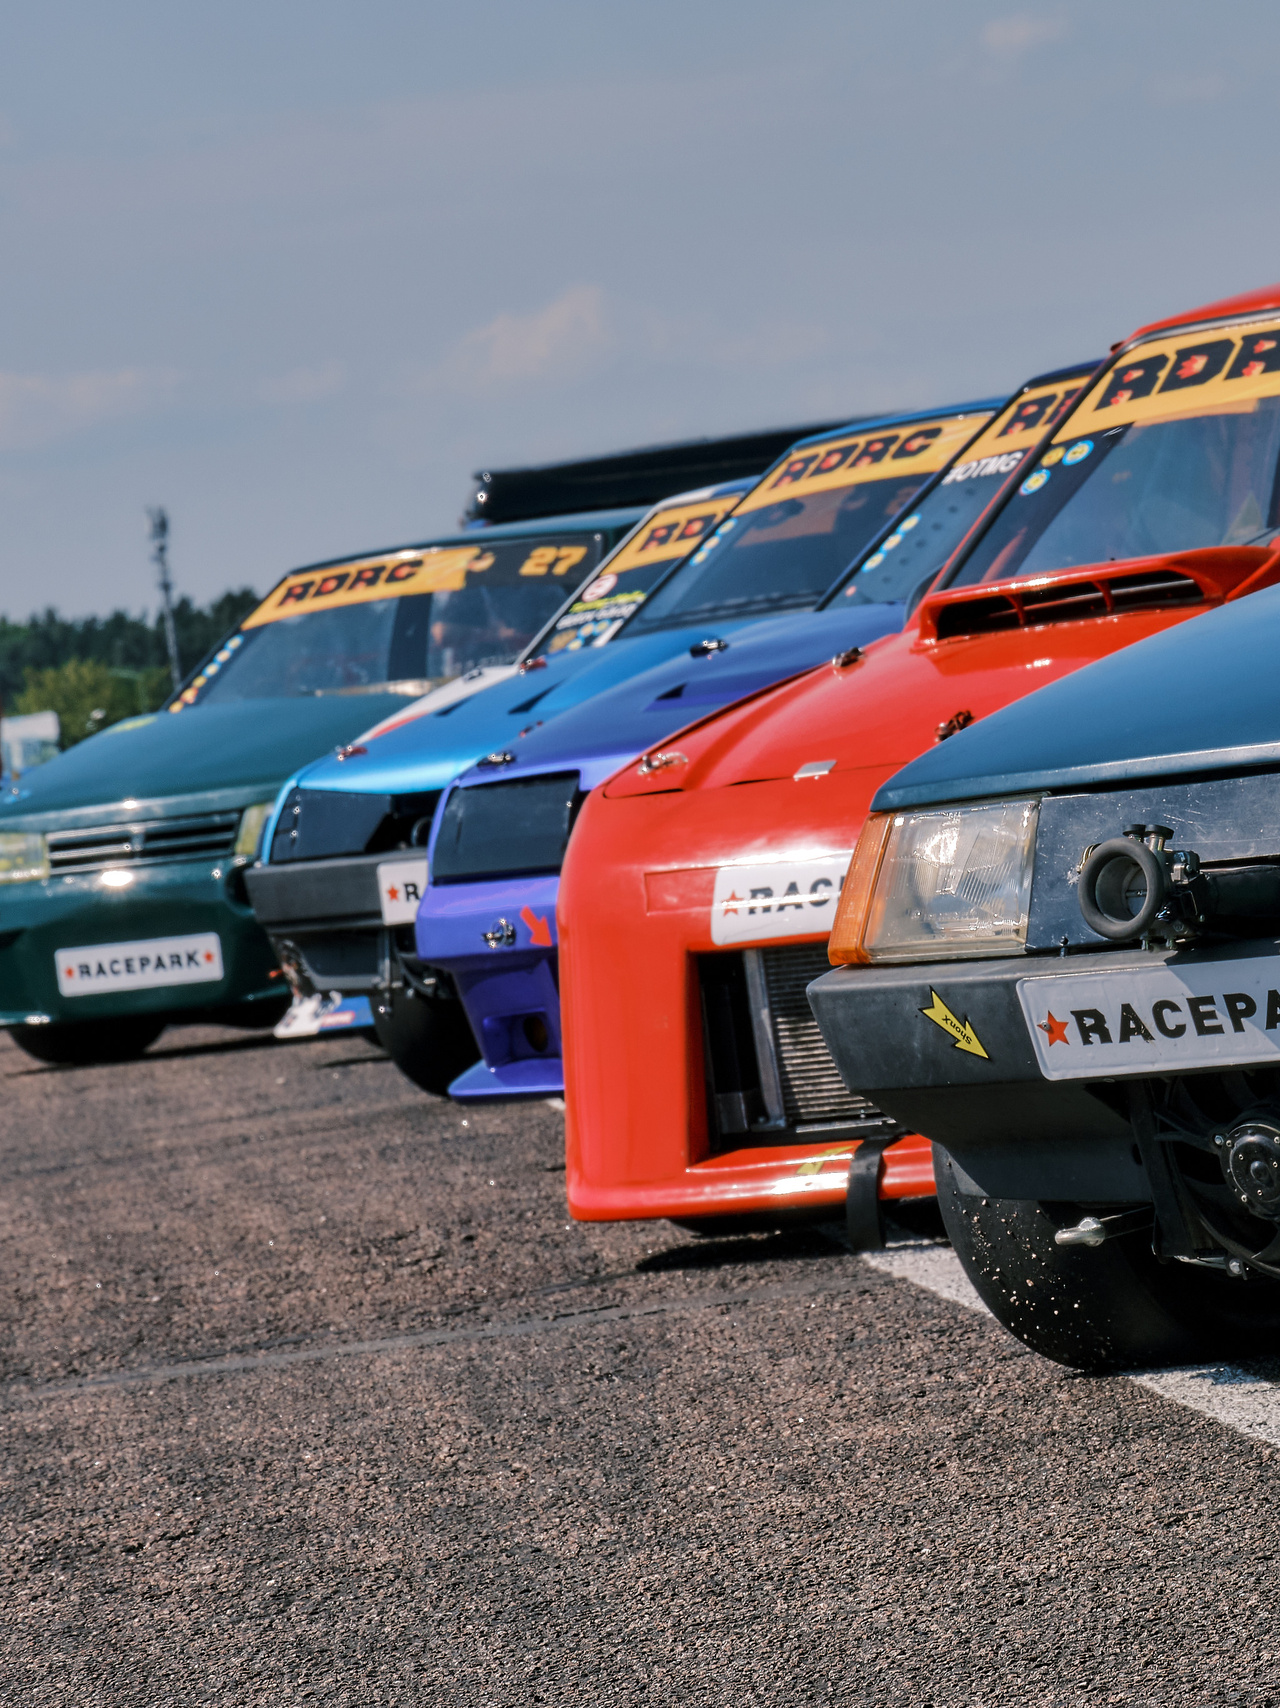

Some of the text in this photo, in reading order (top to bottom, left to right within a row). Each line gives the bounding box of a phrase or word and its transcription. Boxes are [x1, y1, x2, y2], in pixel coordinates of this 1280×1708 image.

[768, 427, 942, 491] RDRC
[519, 547, 587, 576] 27
[278, 560, 423, 608] RDRC
[78, 950, 201, 978] RACEPARK
